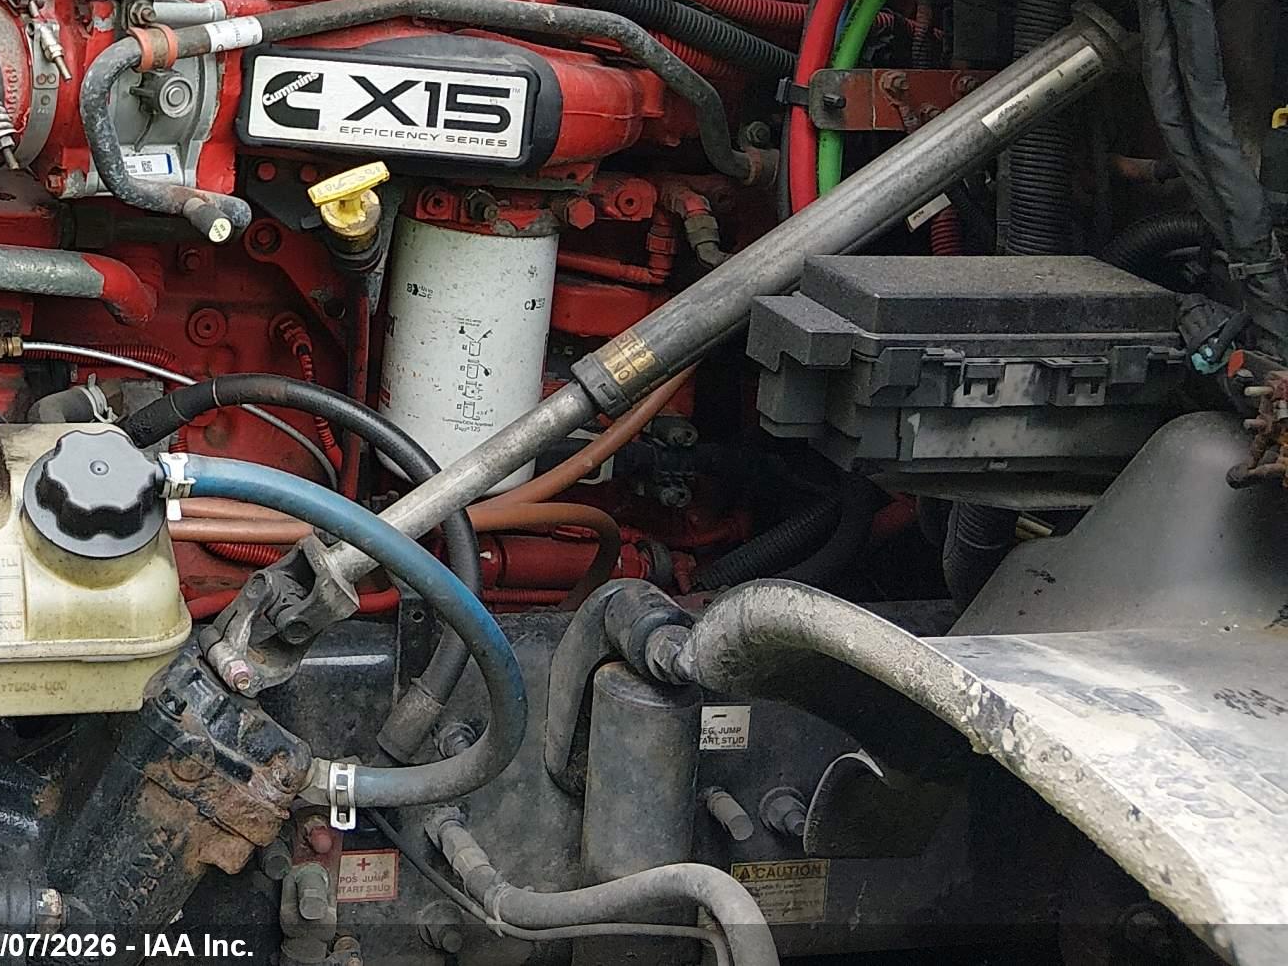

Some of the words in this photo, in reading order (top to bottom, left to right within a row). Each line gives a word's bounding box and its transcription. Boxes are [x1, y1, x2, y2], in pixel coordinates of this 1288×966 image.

[262, 70, 321, 107] Cummins
[343, 74, 511, 133] X15
[339, 125, 439, 143] EFFICIENCY
[445, 134, 509, 148] SERIES
[718, 726, 742, 735] JUMP
[721, 736, 745, 745] STUD
[756, 865, 821, 879] CAUTION
[340, 875, 358, 884] POS
[362, 873, 389, 883] JUMP
[338, 885, 363, 894] TART
[366, 884, 390, 894] STUD
